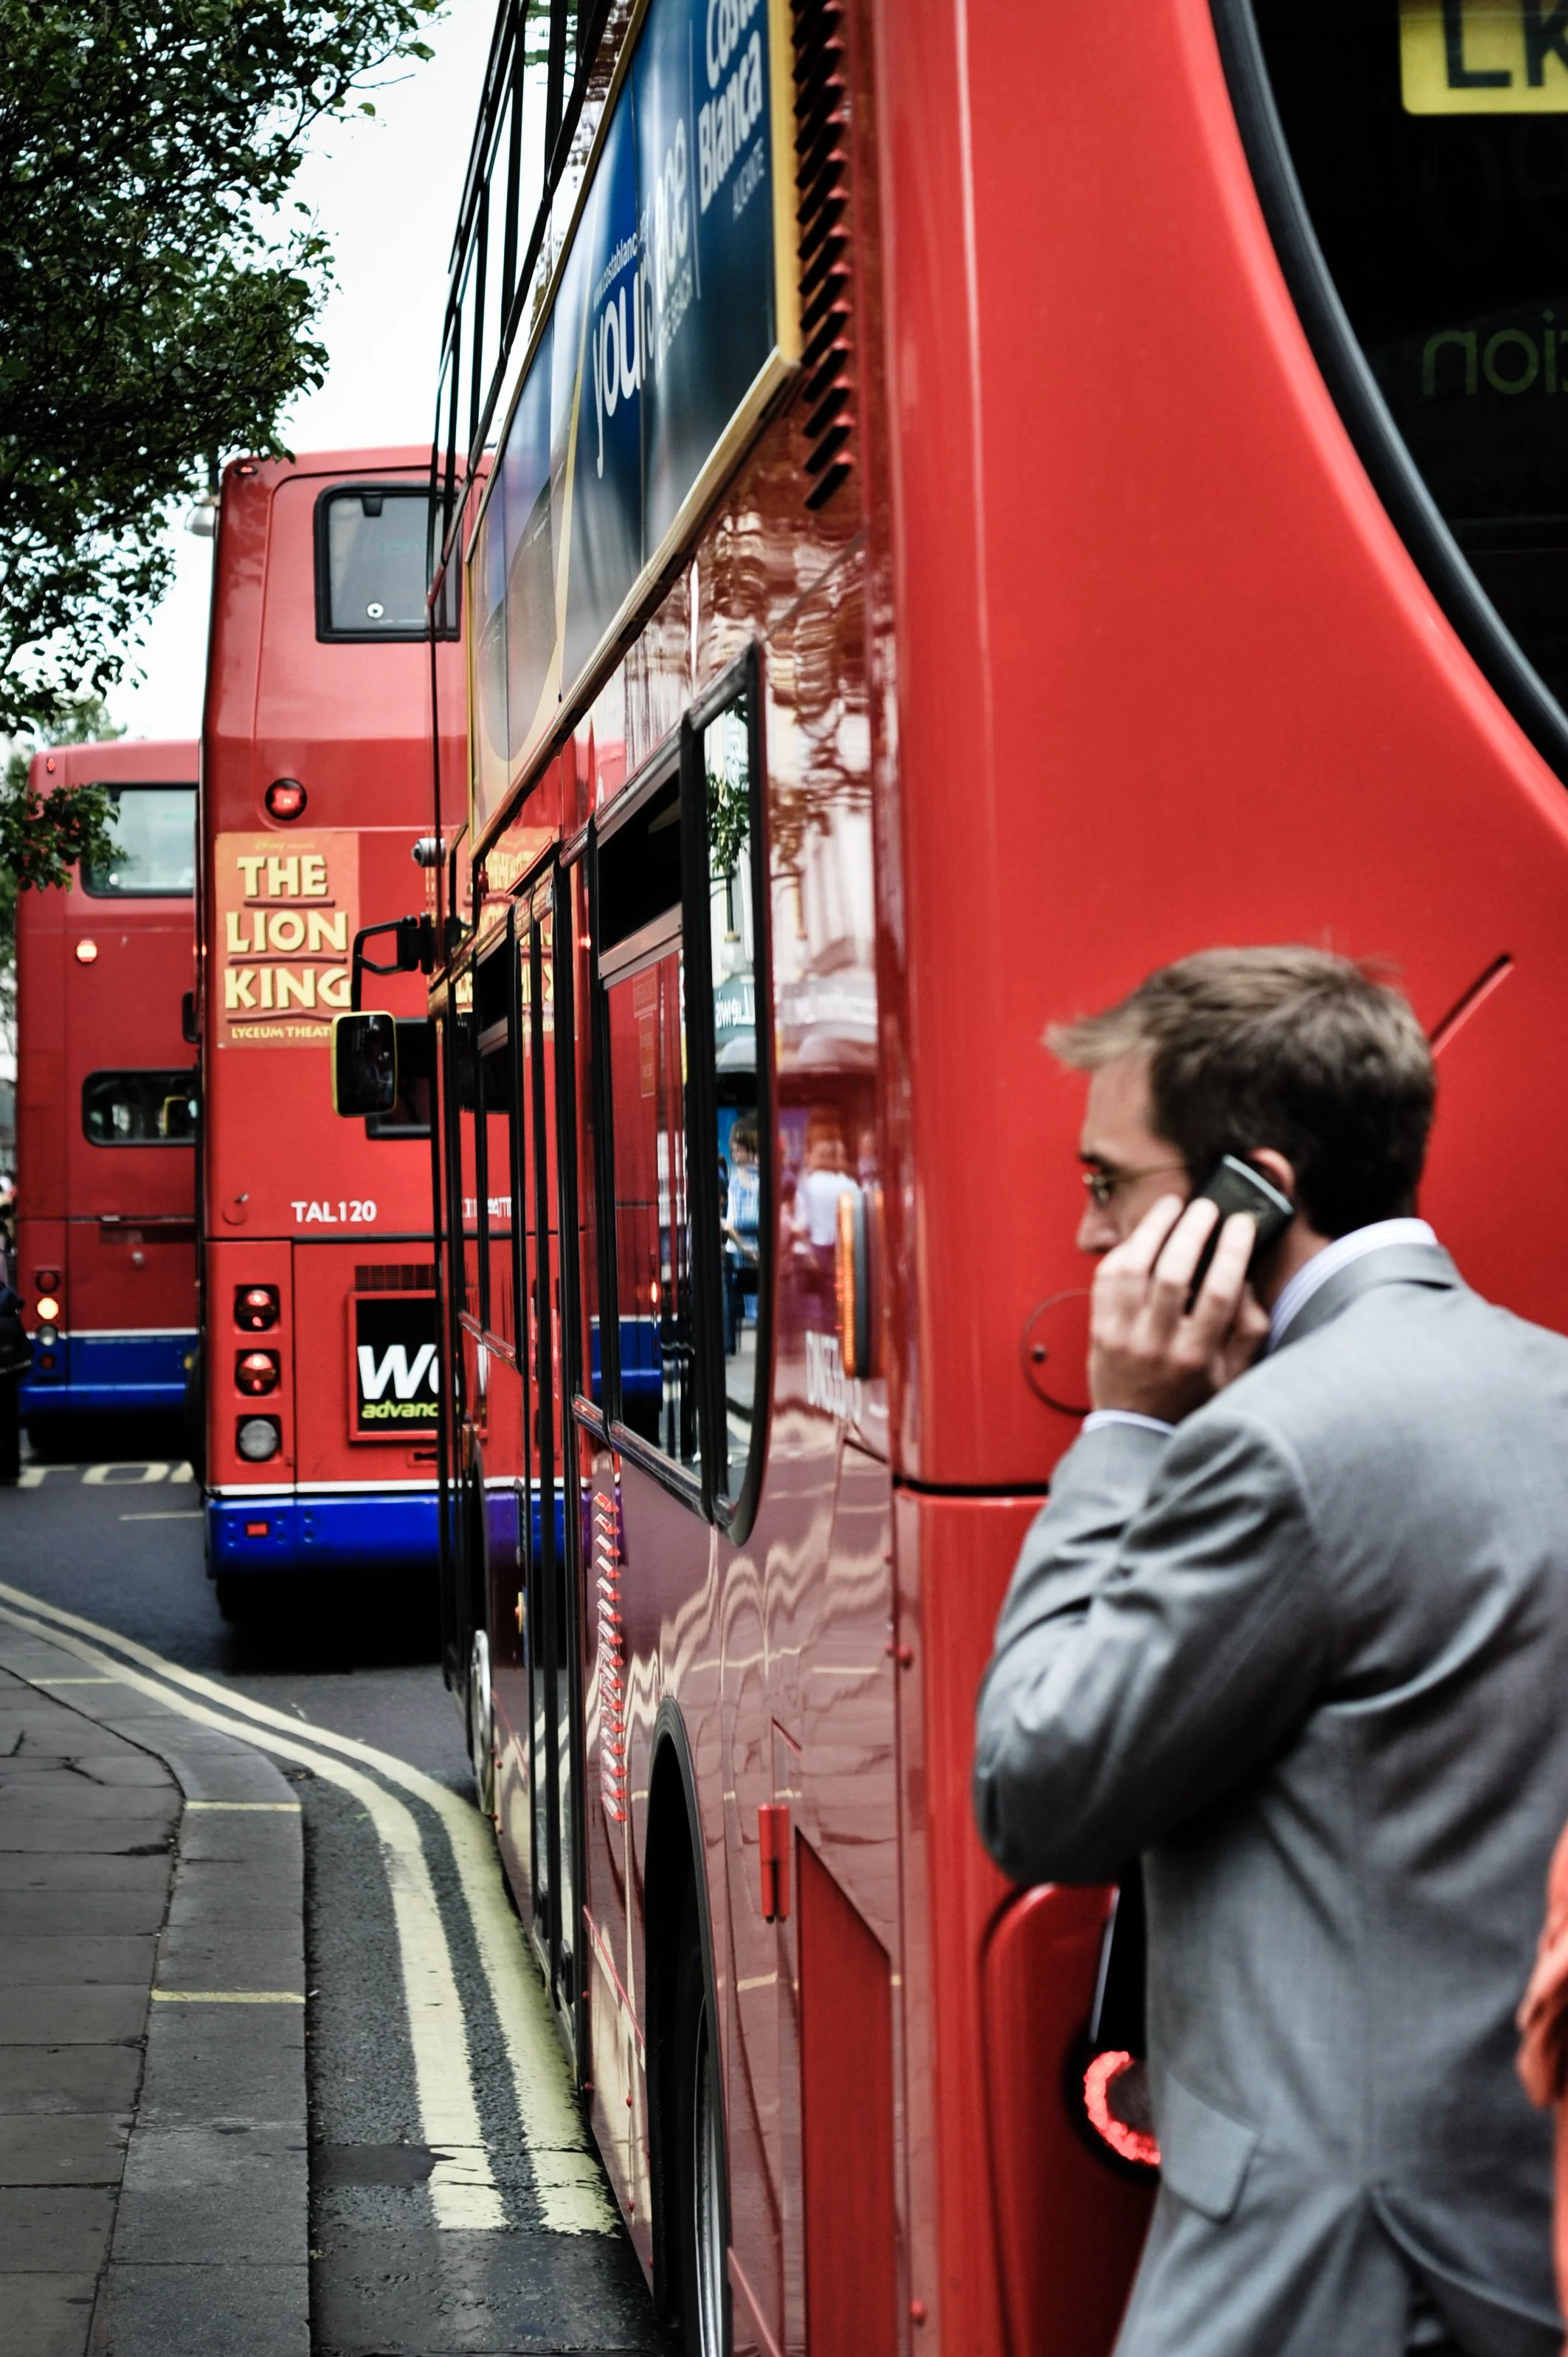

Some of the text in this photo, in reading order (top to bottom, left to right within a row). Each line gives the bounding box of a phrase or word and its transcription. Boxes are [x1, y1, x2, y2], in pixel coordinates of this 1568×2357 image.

[705, 0, 759, 89] Cos
[699, 30, 762, 215] Blanca
[237, 855, 328, 897] THE
[226, 911, 347, 953] LION
[224, 967, 351, 1009] KING
[232, 1025, 331, 1039] LYCEUM THEAT
[290, 1199, 377, 1223] TAL120
[357, 1343, 438, 1400] W
